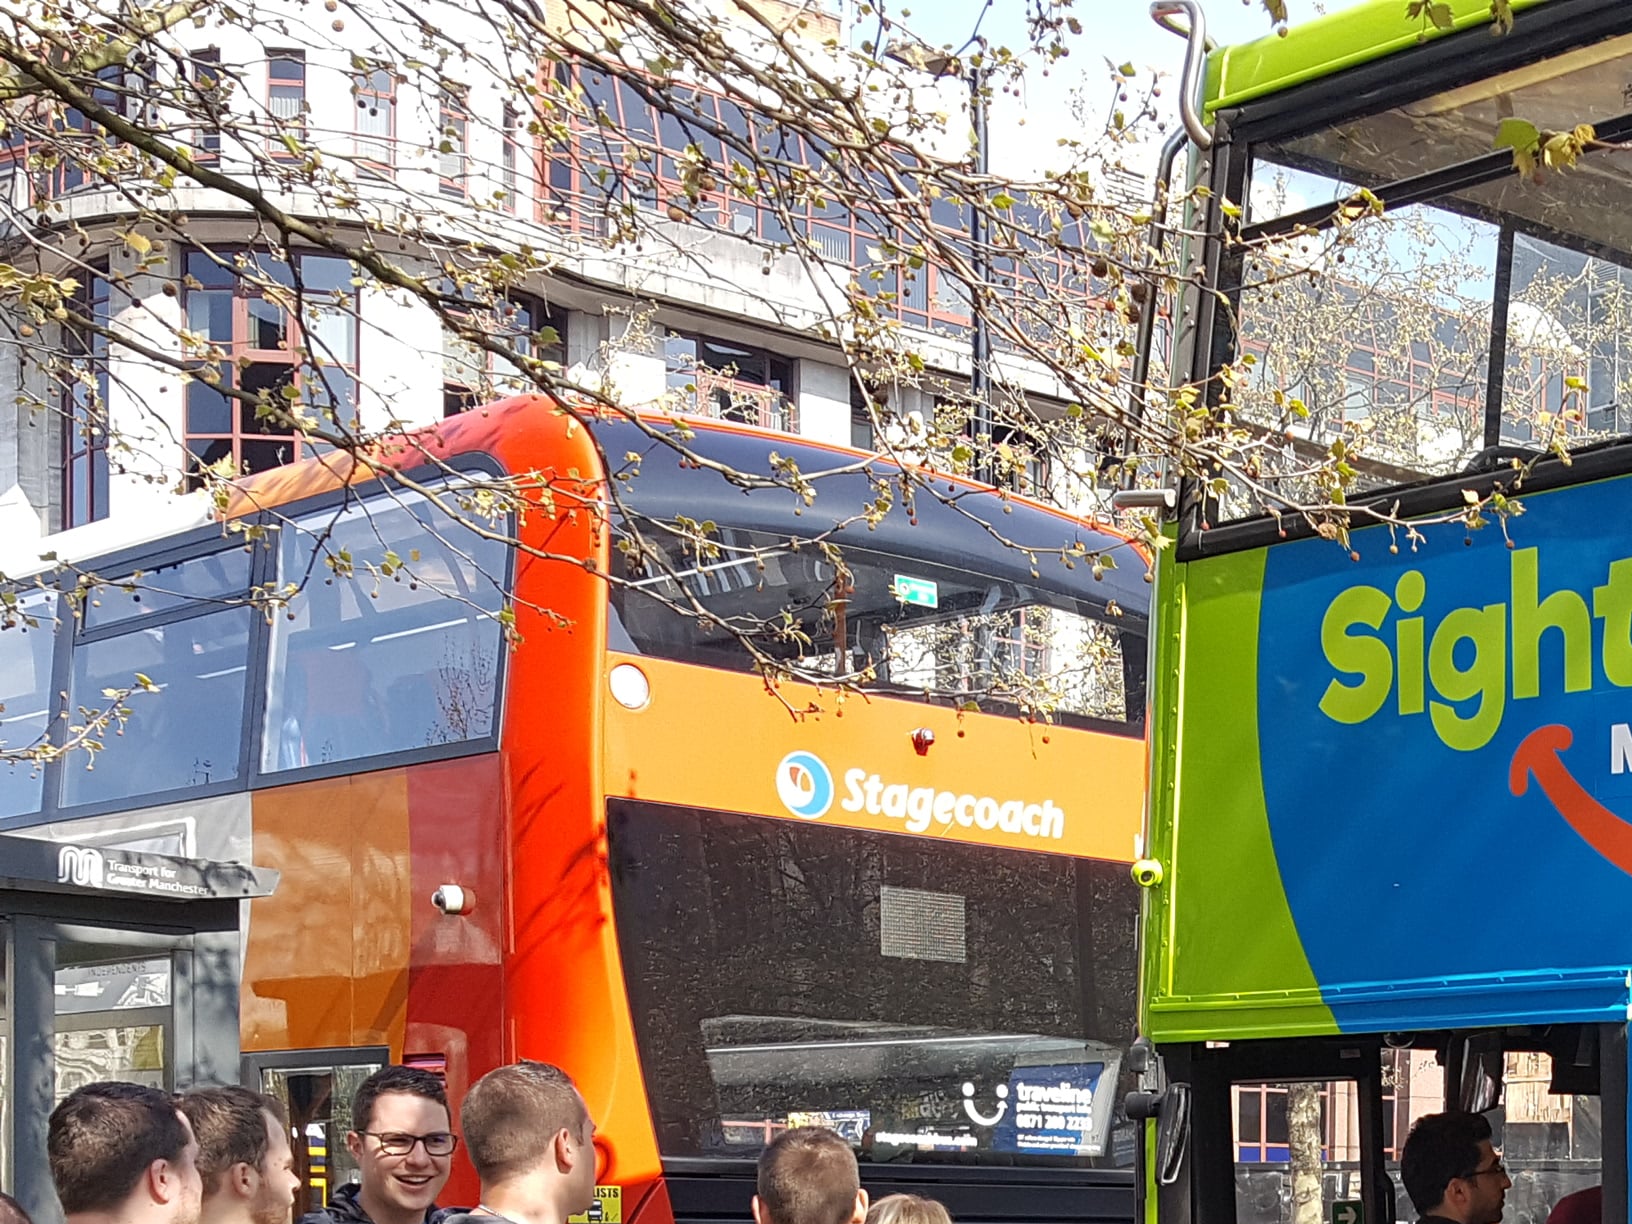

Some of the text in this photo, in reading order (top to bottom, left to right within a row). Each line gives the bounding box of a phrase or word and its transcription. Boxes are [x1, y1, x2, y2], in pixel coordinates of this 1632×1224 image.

[841, 768, 1065, 839] Stagecoach
[107, 859, 177, 878] Transport for
[106, 873, 209, 895] Greater Manchester
[1016, 1082, 1092, 1104] traveline
